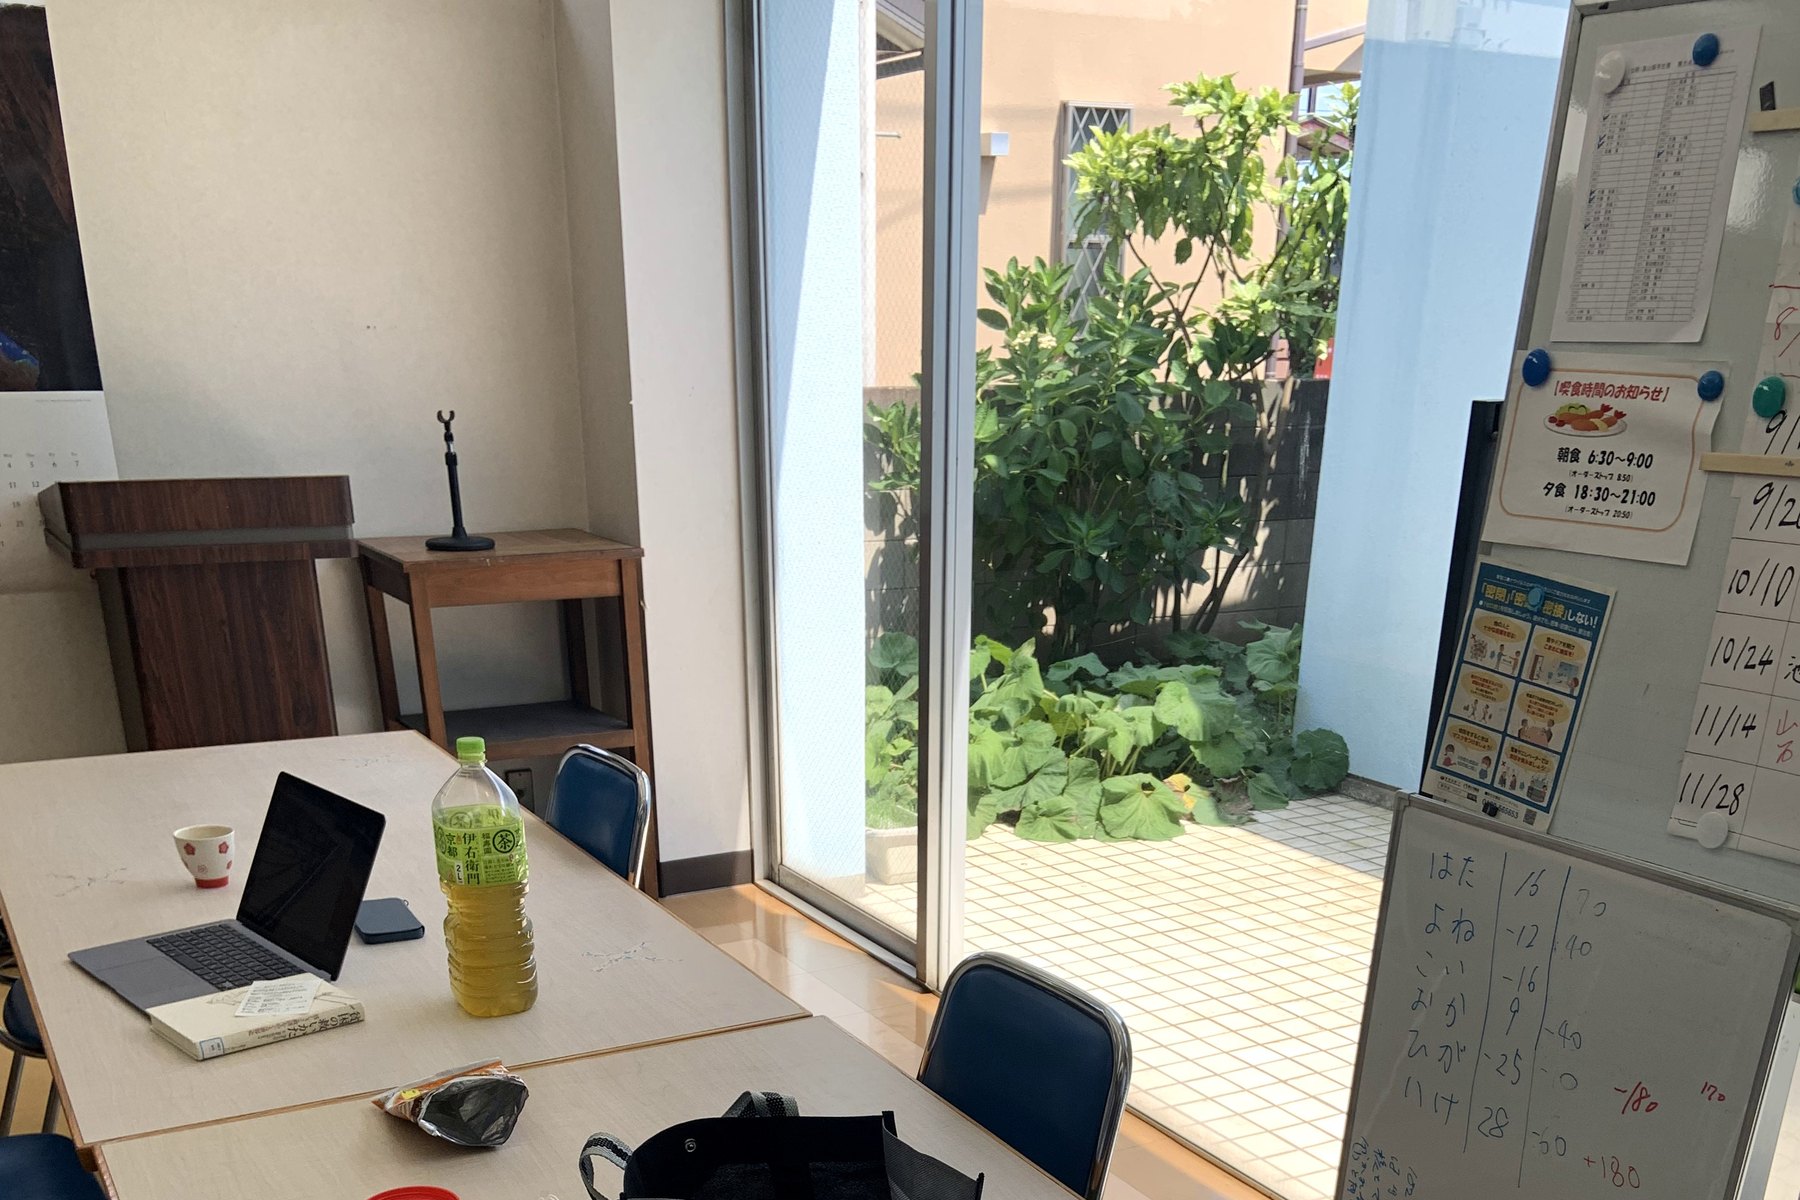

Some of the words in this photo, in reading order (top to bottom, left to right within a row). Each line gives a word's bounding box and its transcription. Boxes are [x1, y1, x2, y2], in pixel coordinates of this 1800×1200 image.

[1557, 446, 1581, 463] 朝食
[1543, 482, 1567, 498] 夕食
[1710, 635, 1774, 676] 10/24
[1695, 704, 1757, 746] 11/14
[1679, 772, 1744, 816] 11/28
[462, 832, 481, 886] 伊右衛門
[495, 831, 514, 851] 茶
[1429, 850, 1475, 889] はた
[1425, 903, 1475, 944] よね
[1477, 1106, 1510, 1139] 28
